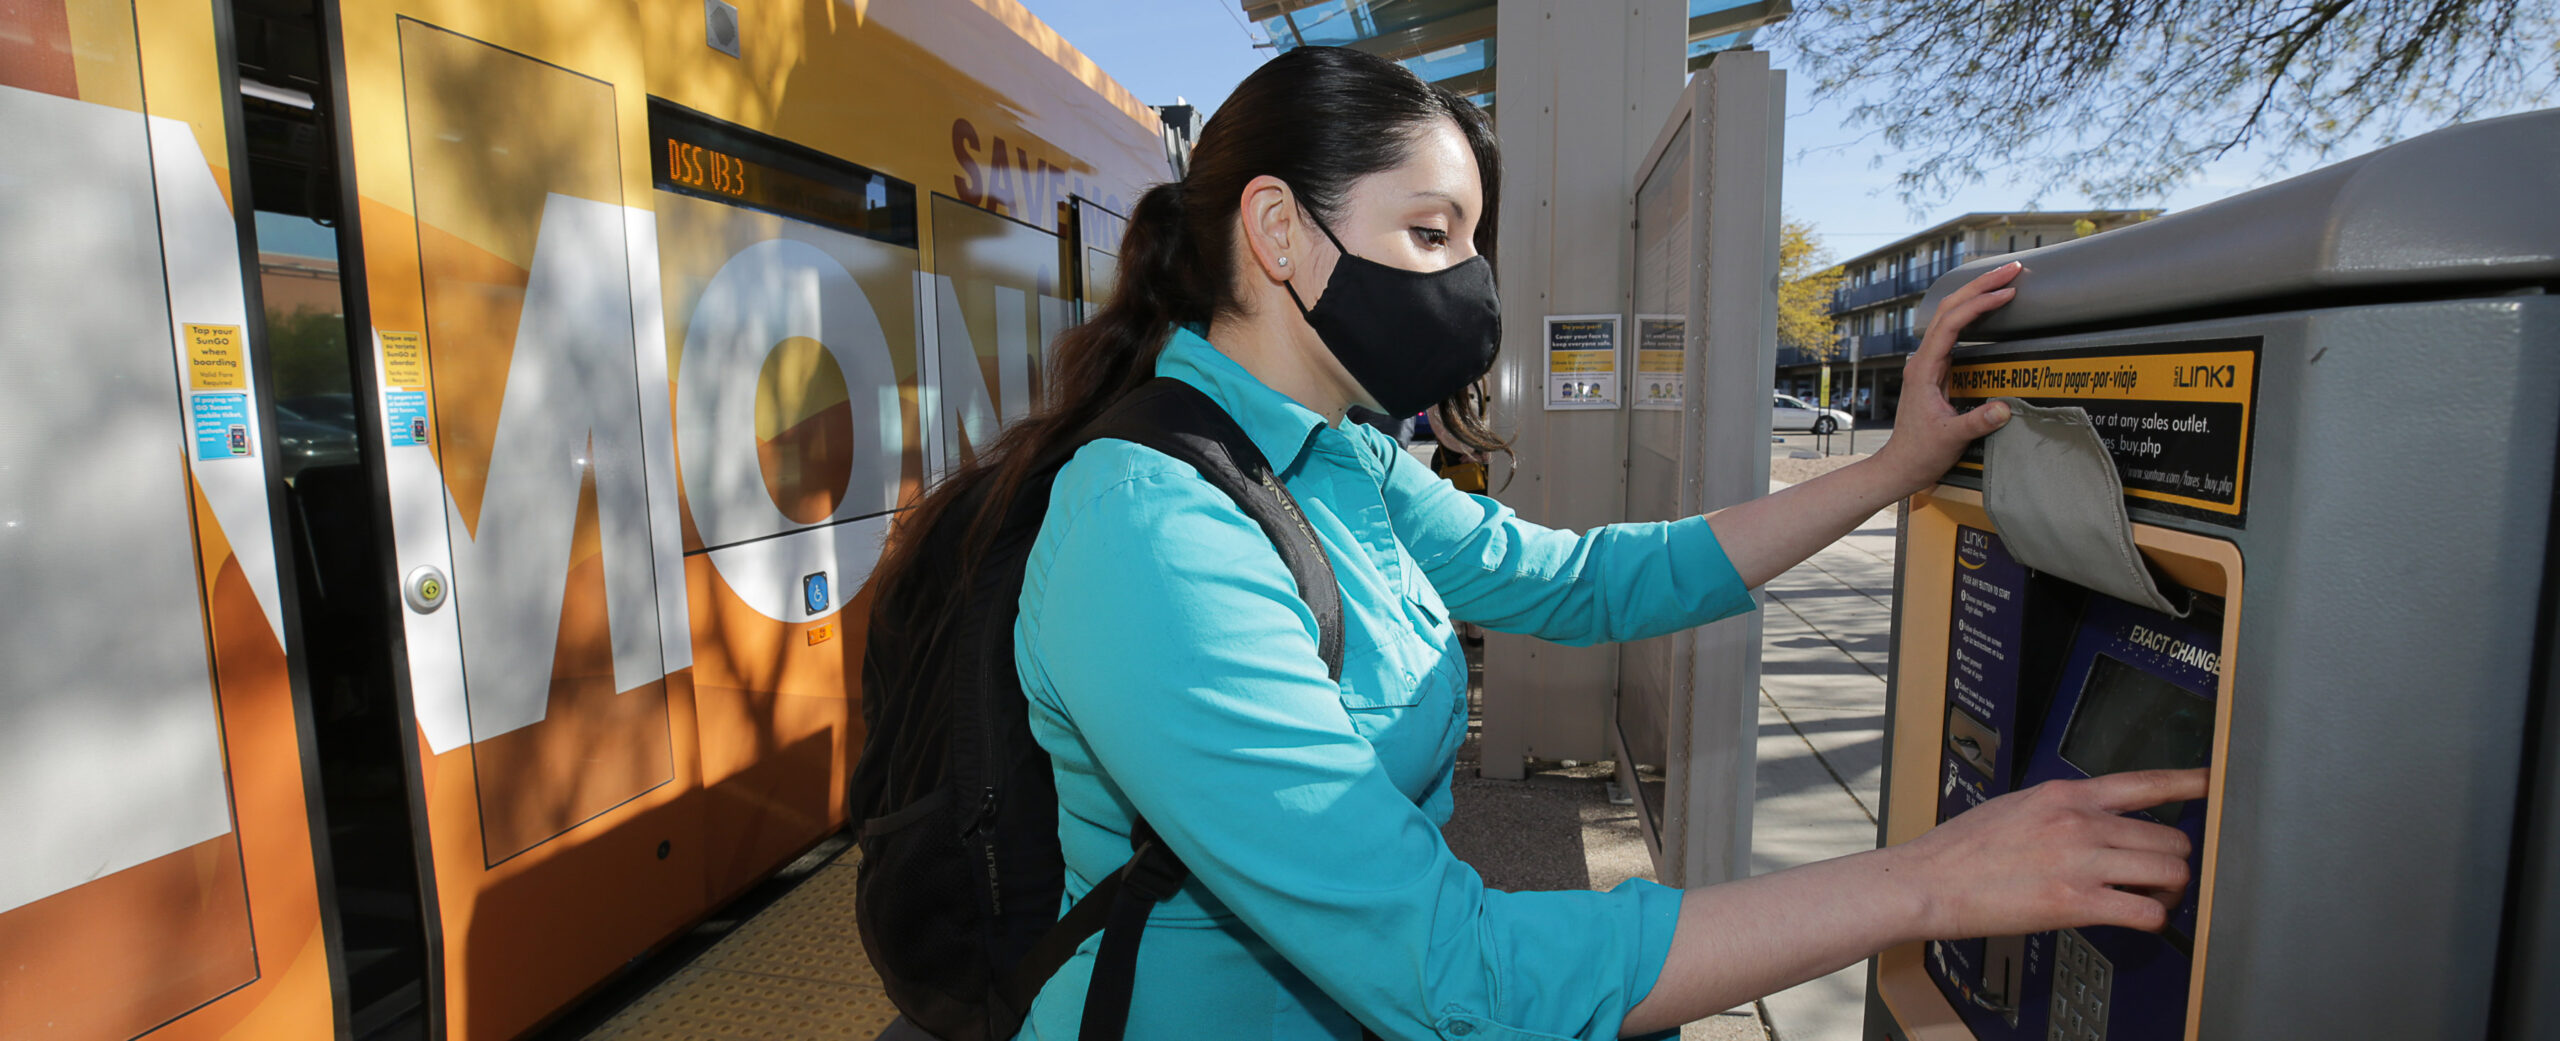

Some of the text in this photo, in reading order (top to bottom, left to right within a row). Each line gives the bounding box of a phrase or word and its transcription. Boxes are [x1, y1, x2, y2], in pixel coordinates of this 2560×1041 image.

[668, 138, 703, 186] DSS
[952, 117, 1068, 239] SAVE
[191, 326, 233, 337] Tap your
[196, 338, 229, 346] SunGO
[193, 358, 237, 368] boarding
[2064, 364, 2137, 394] pagar-por-viaje
[2179, 365, 2226, 388] LINK
[2095, 415, 2106, 425] or
[2108, 412, 2118, 426] at
[2120, 415, 2139, 432] any
[2142, 412, 2169, 430] sales
[2172, 414, 2210, 433] outlet.
[2129, 625, 2222, 676] EXACT CHANGE
